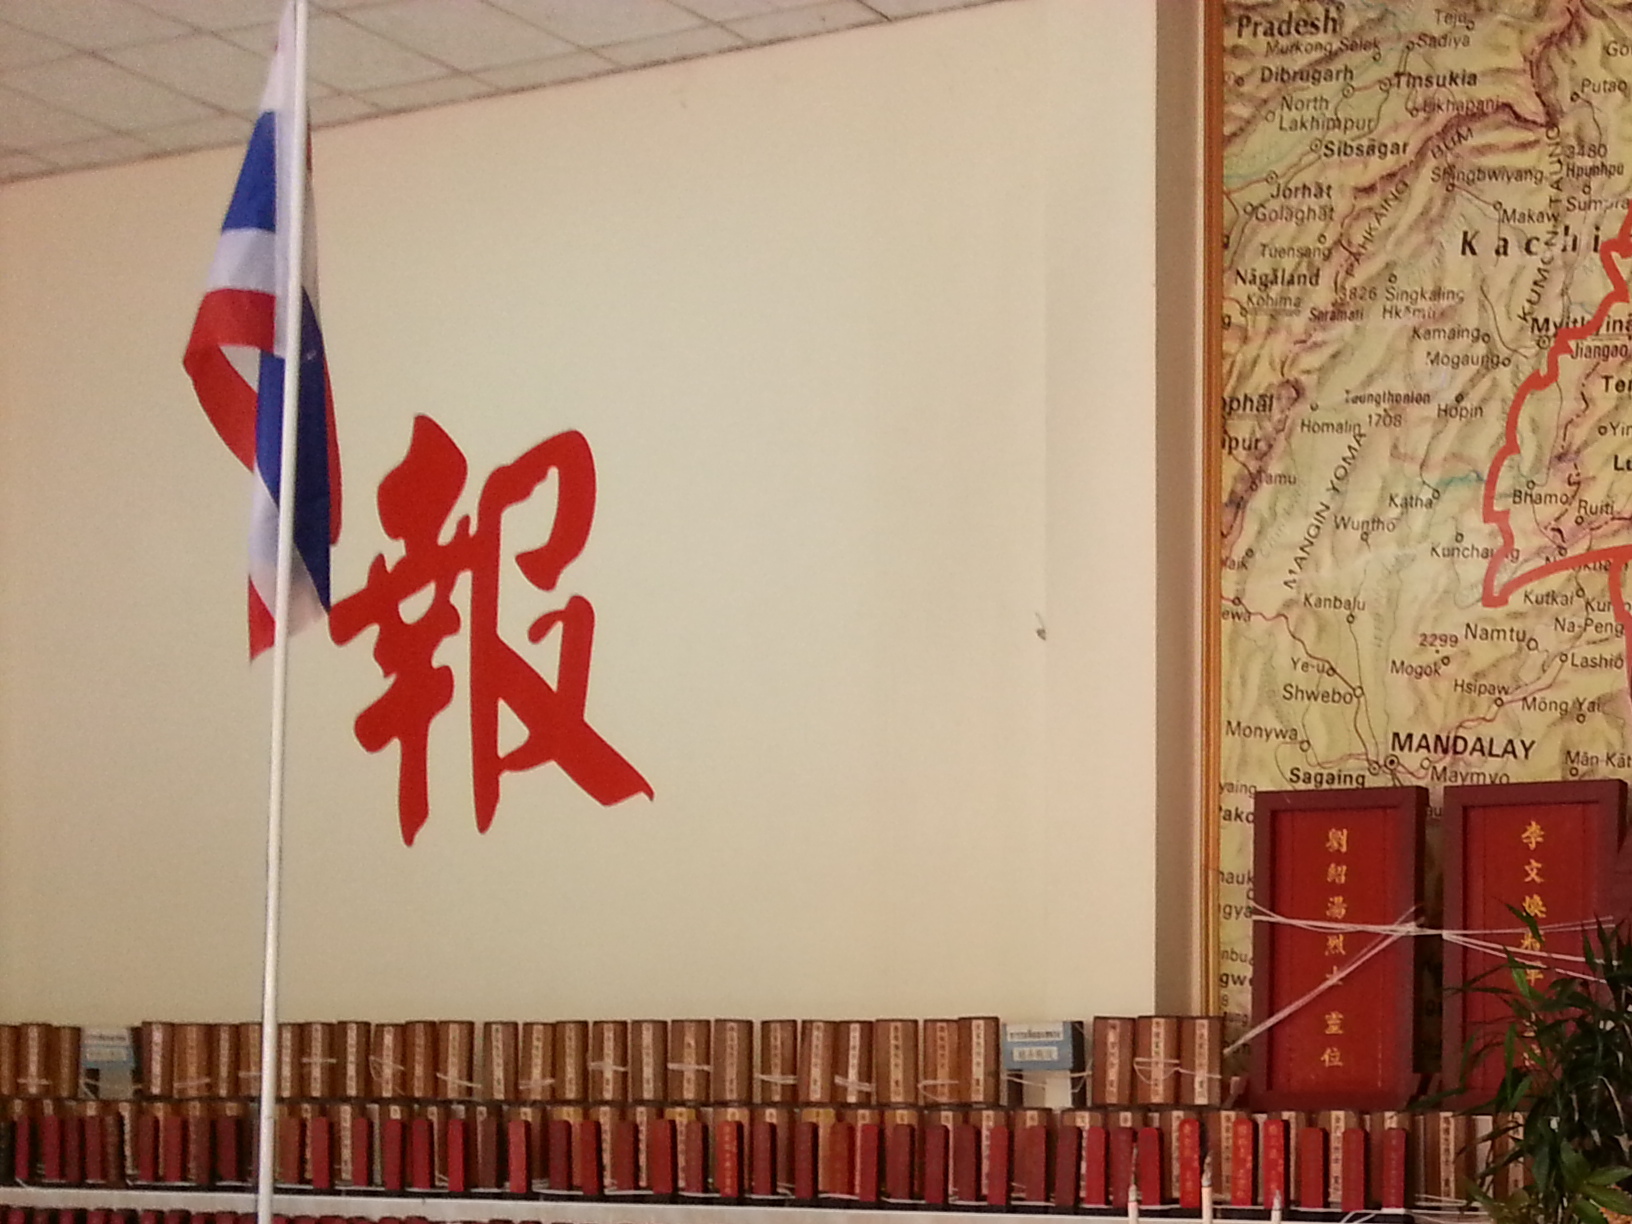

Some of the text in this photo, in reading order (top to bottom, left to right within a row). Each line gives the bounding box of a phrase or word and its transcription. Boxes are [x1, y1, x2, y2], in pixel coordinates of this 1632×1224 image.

[1237, 10, 1339, 39] Pradesh
[1418, 34, 1471, 52] Sadiya
[1260, 64, 1354, 84] Dibrugarh
[1582, 79, 1627, 97] Putao
[1281, 95, 1329, 111] North
[1412, 325, 1481, 344] Kamaing
[1437, 404, 1483, 421] Hopin
[1389, 496, 1433, 510] Katha
[1334, 514, 1396, 534] Wuntho
[328, 414, 654, 847] 報
[1465, 623, 1527, 643] Namtu
[1391, 659, 1441, 678] Mogok
[1282, 685, 1353, 705] Shwebo
[1454, 680, 1510, 698] Hsipaw
[1226, 720, 1299, 741] Monywa
[1391, 733, 1537, 761] MANDALAY
[1290, 768, 1366, 789] Sagaing
